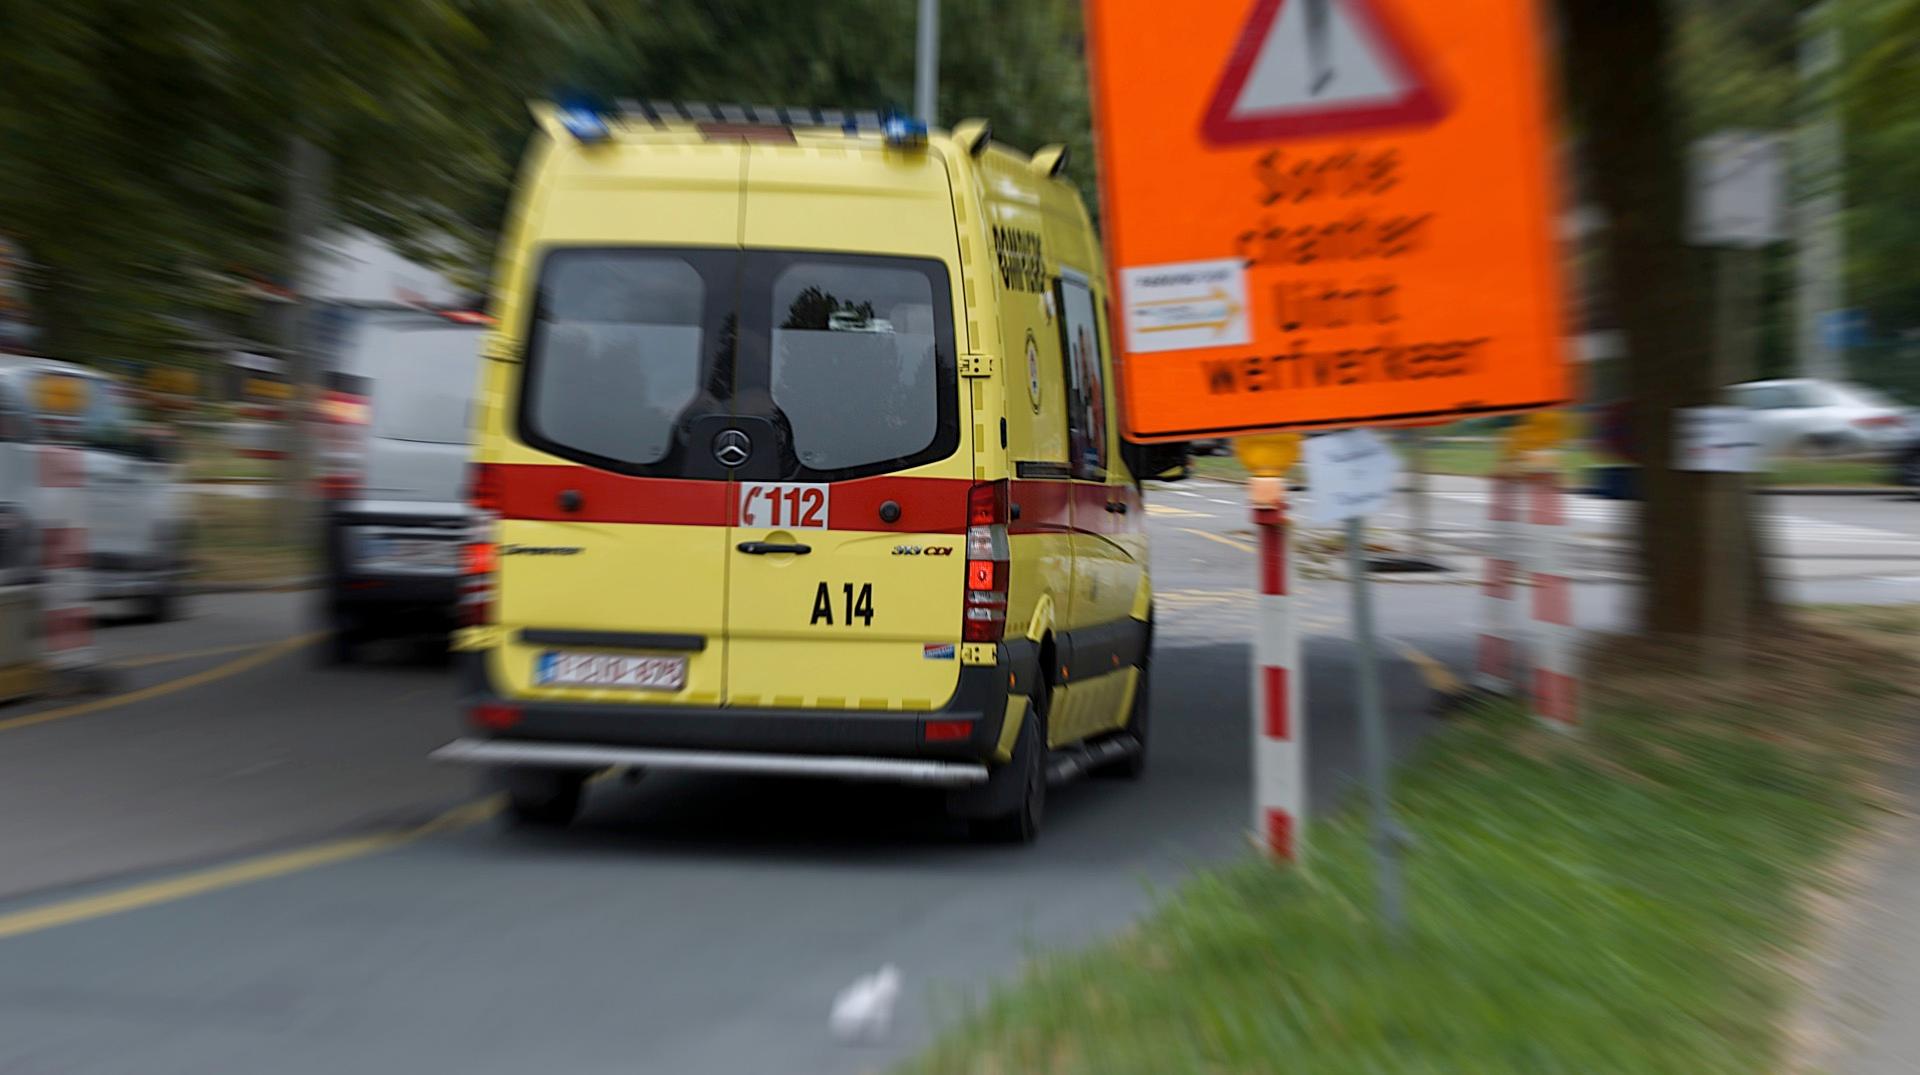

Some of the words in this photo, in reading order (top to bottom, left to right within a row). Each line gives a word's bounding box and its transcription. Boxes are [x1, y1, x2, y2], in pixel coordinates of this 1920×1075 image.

[765, 487, 825, 528] 112
[810, 581, 834, 626] A
[843, 582, 875, 627] 14
